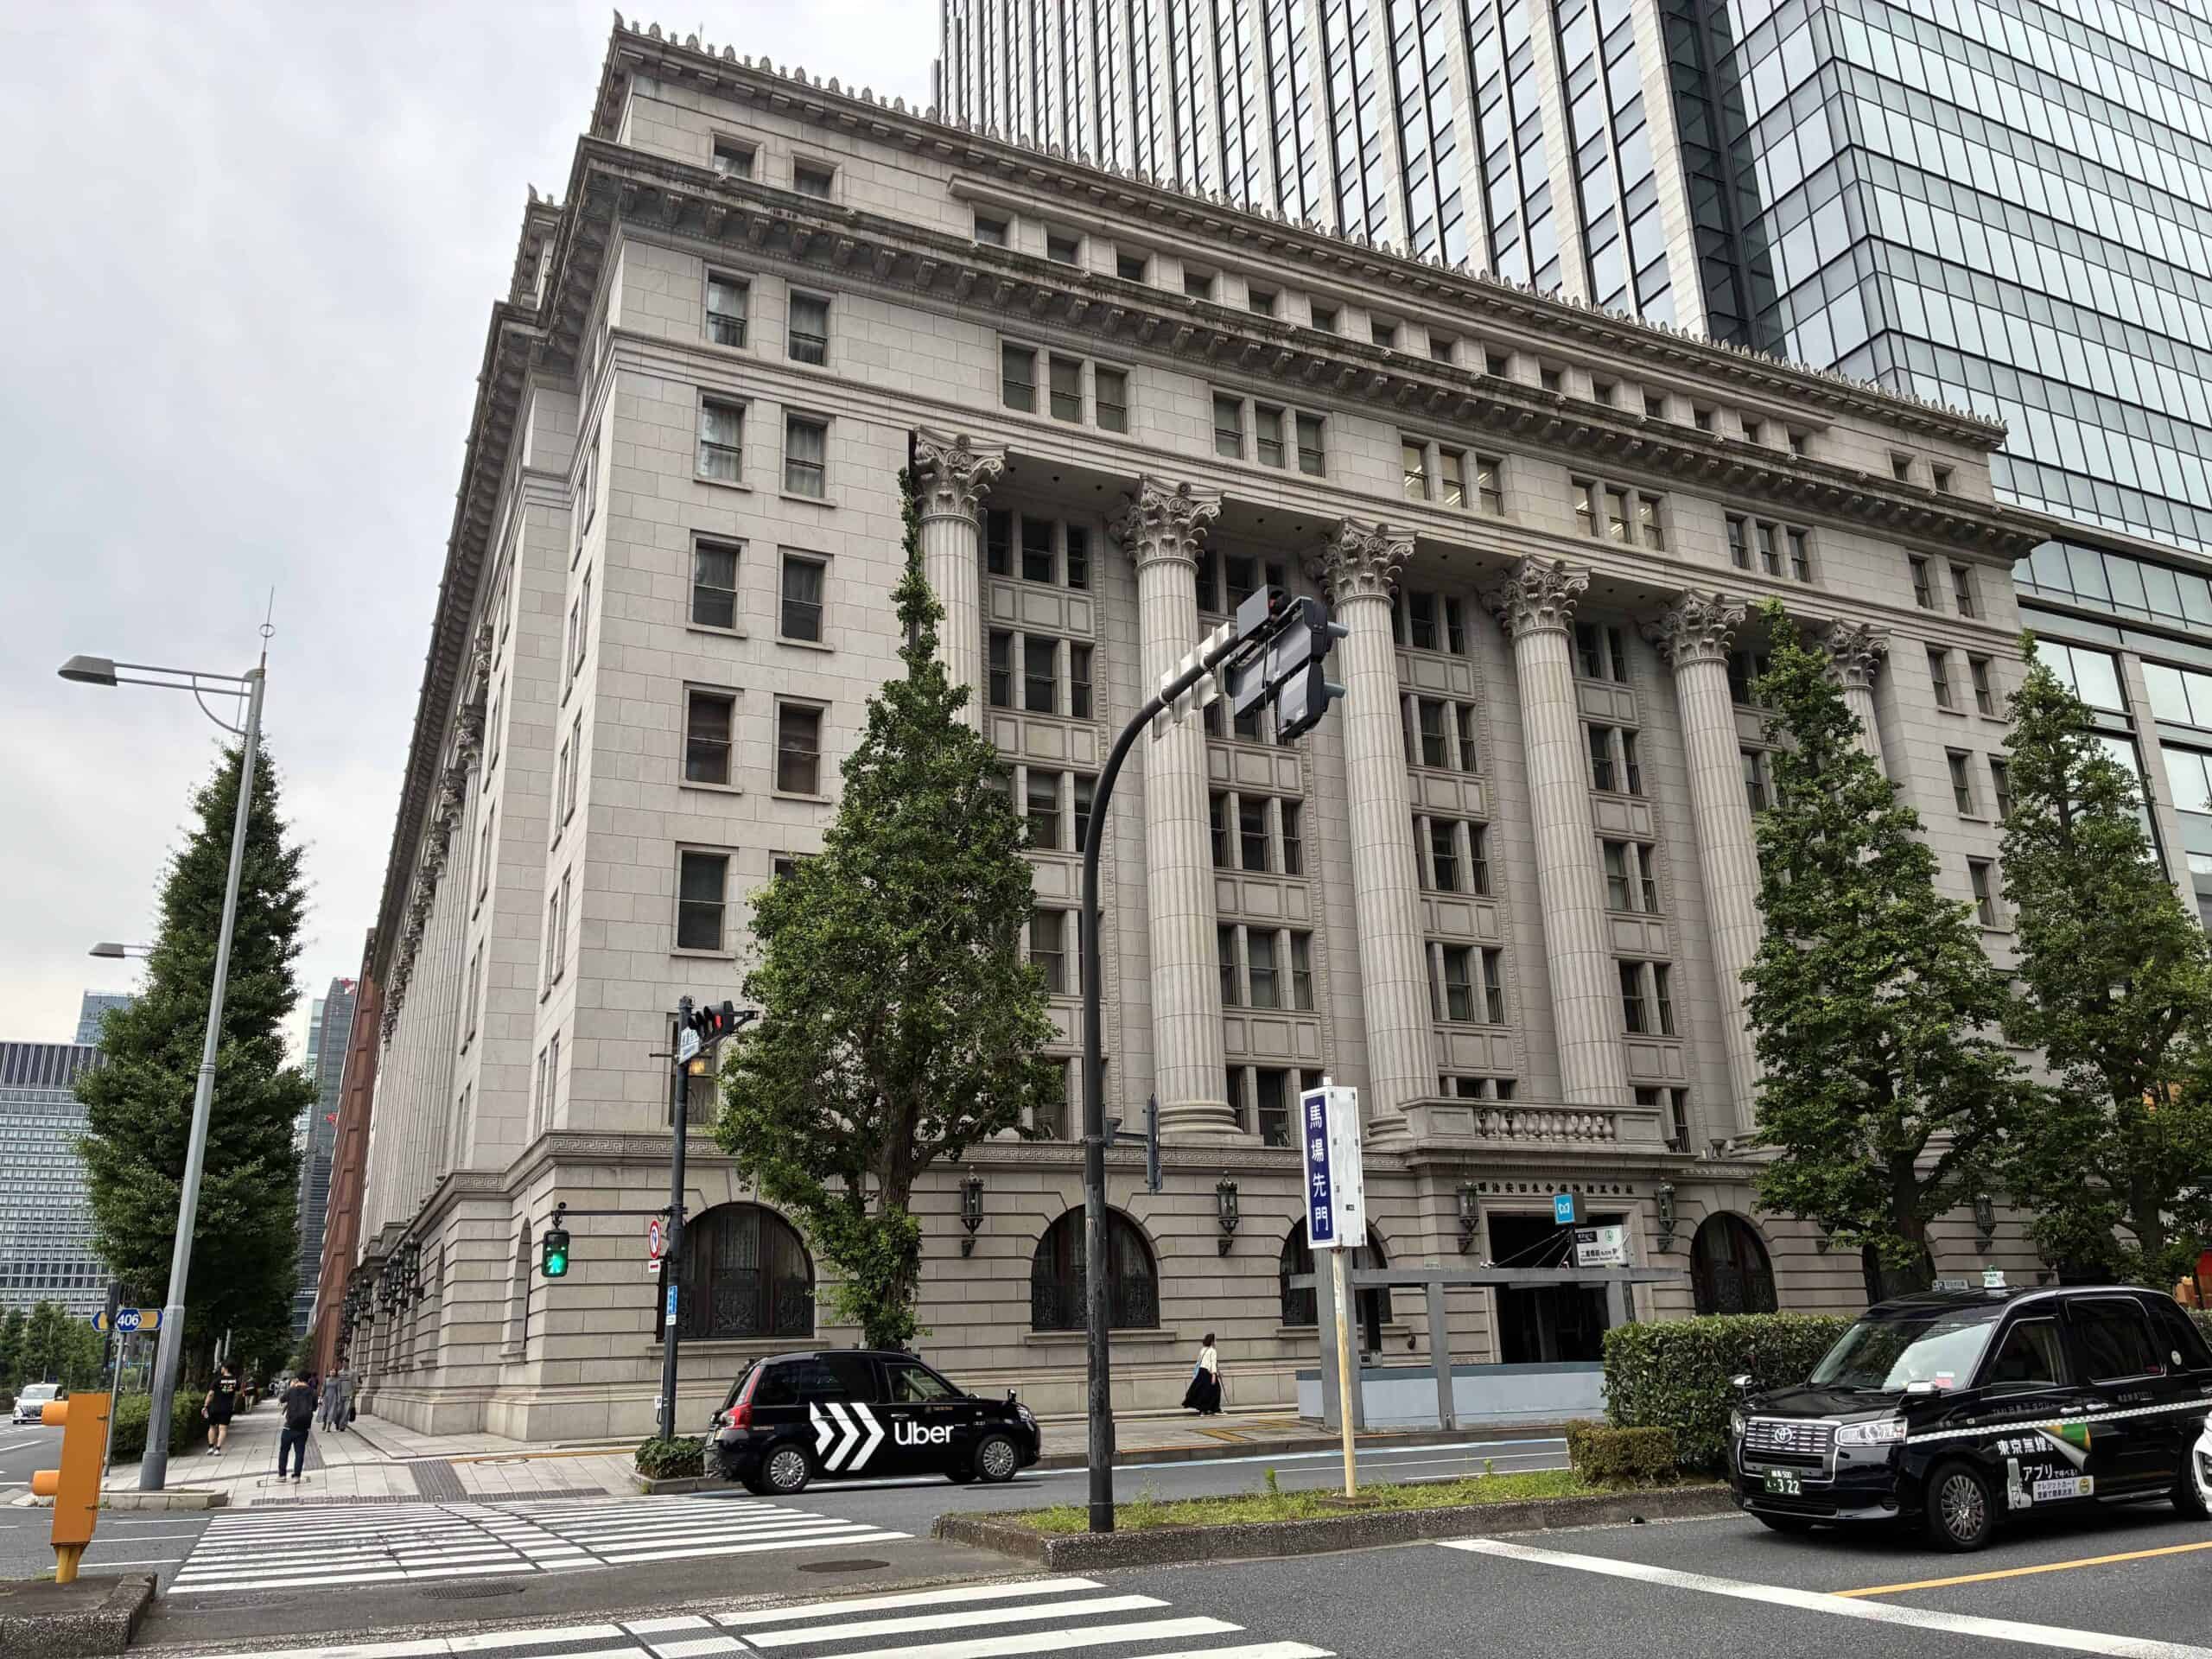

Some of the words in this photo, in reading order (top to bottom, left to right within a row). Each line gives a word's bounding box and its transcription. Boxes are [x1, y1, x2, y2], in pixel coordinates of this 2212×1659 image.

[1308, 1104, 1329, 1232] 馬場先門
[117, 1313, 139, 1326] 406
[893, 1421, 954, 1446] Uber
